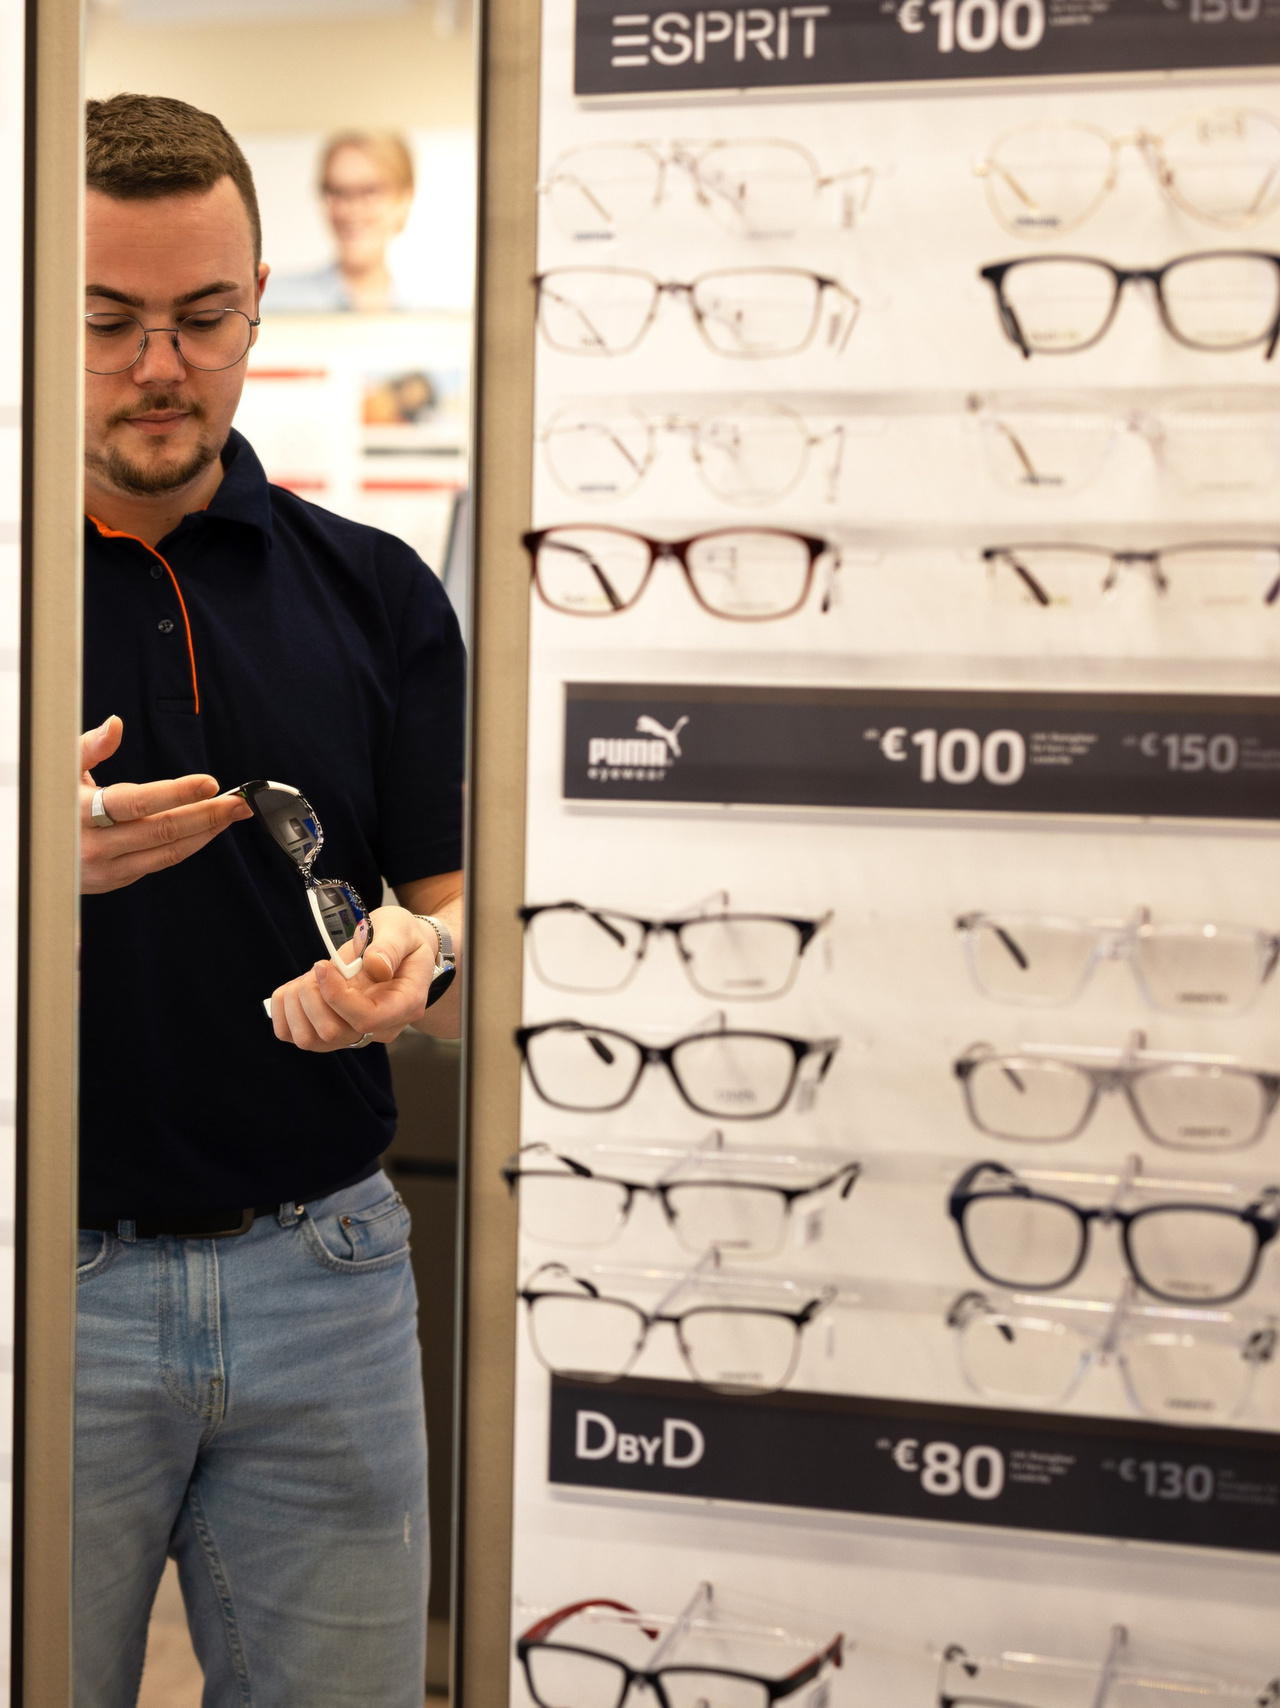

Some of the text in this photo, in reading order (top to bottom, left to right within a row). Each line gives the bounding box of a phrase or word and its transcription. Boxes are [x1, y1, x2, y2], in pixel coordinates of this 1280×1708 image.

[611, 6, 830, 67] ESPRIT
[588, 737, 667, 767] PUMA
[880, 727, 1027, 787] €100
[892, 1438, 1005, 1501] €80
